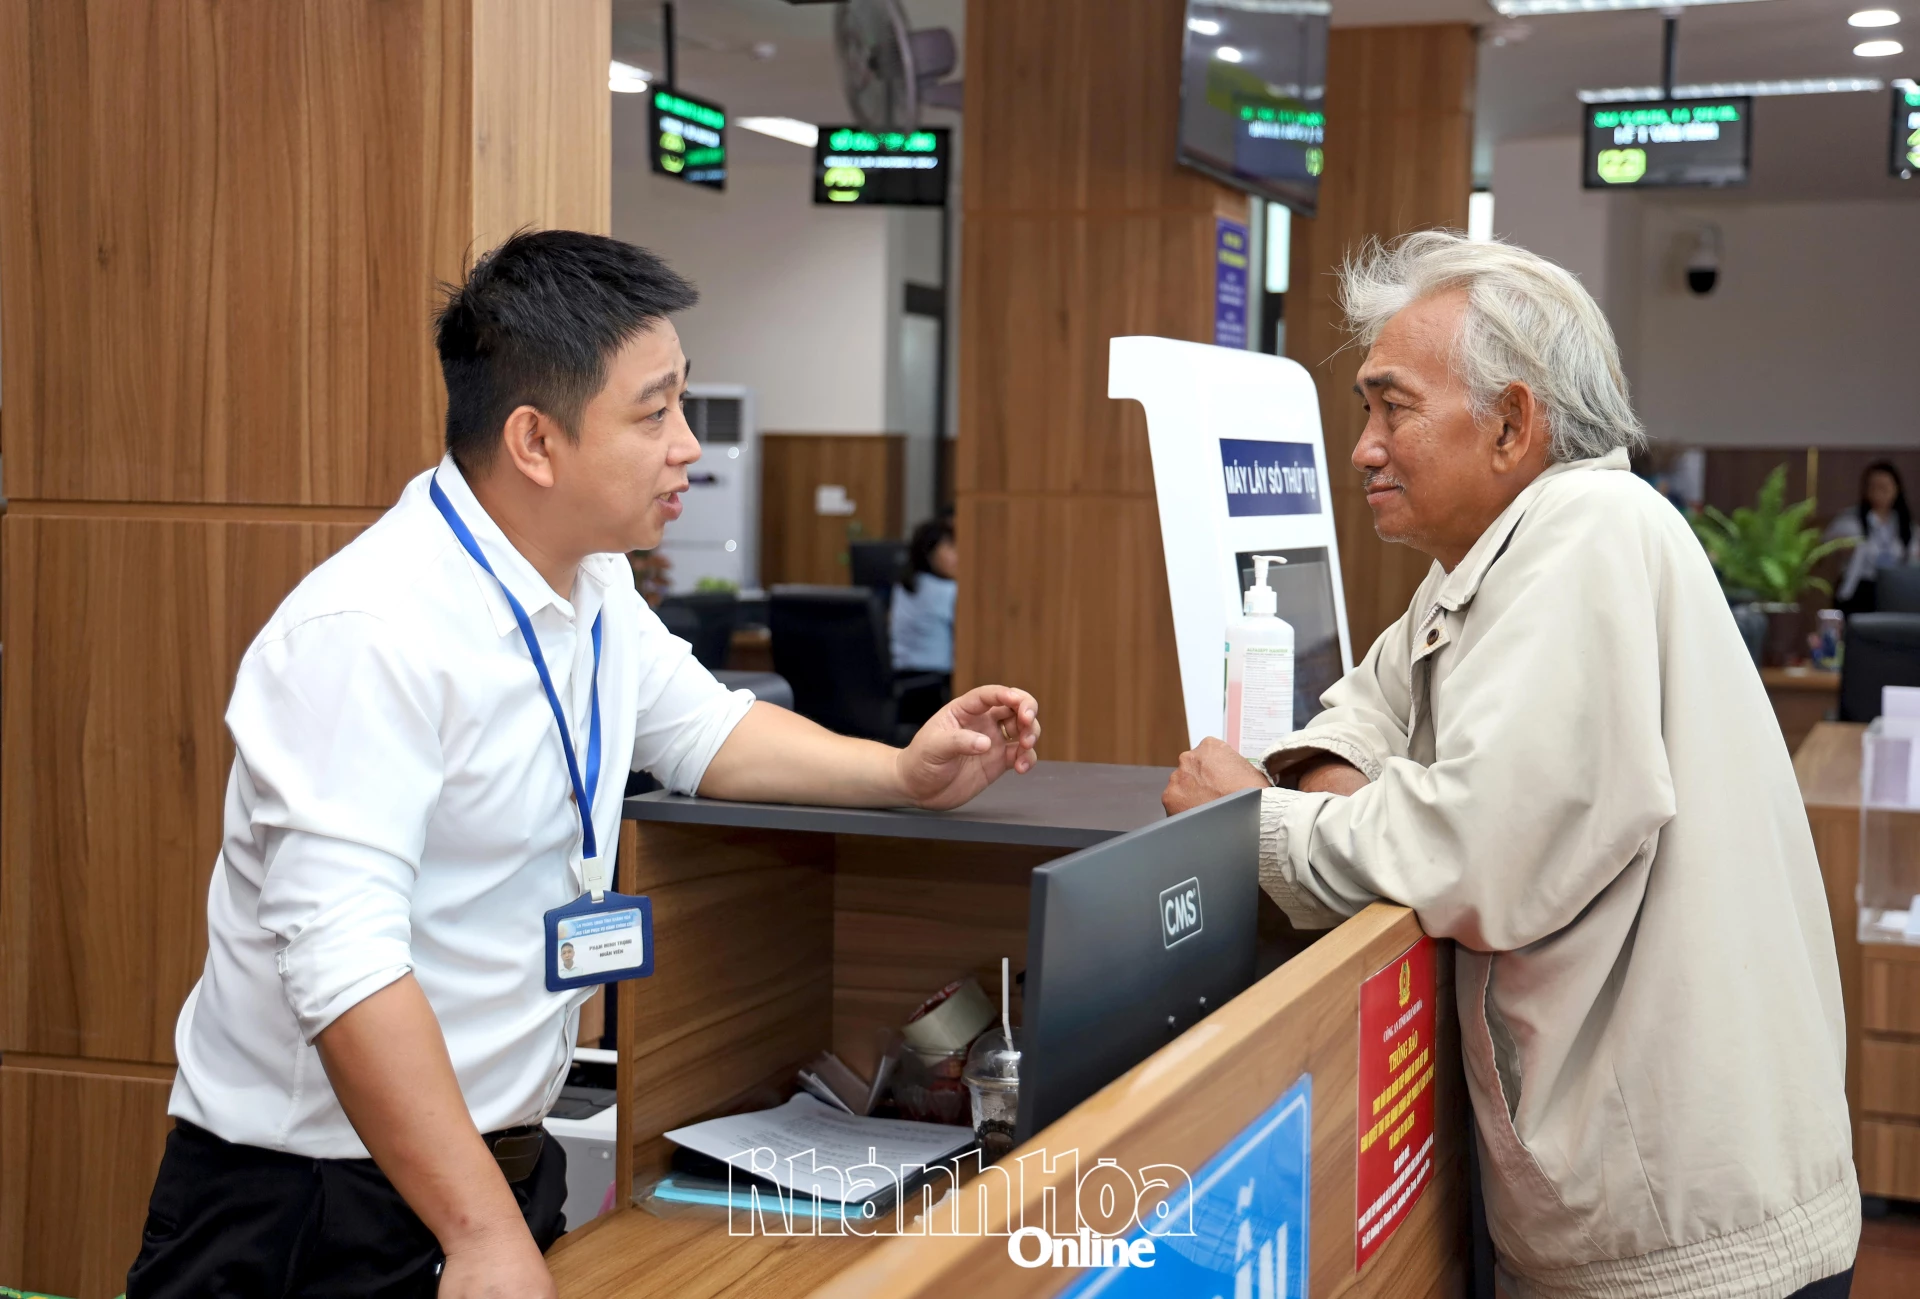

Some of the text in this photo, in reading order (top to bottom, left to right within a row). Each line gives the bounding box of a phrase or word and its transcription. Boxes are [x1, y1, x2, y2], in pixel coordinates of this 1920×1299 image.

[1225, 459, 1248, 494] MÁY
[1268, 460, 1284, 494] SỐ
[1165, 890, 1196, 935] CMS
[1389, 1028, 1418, 1073] THÔNG BÁO
